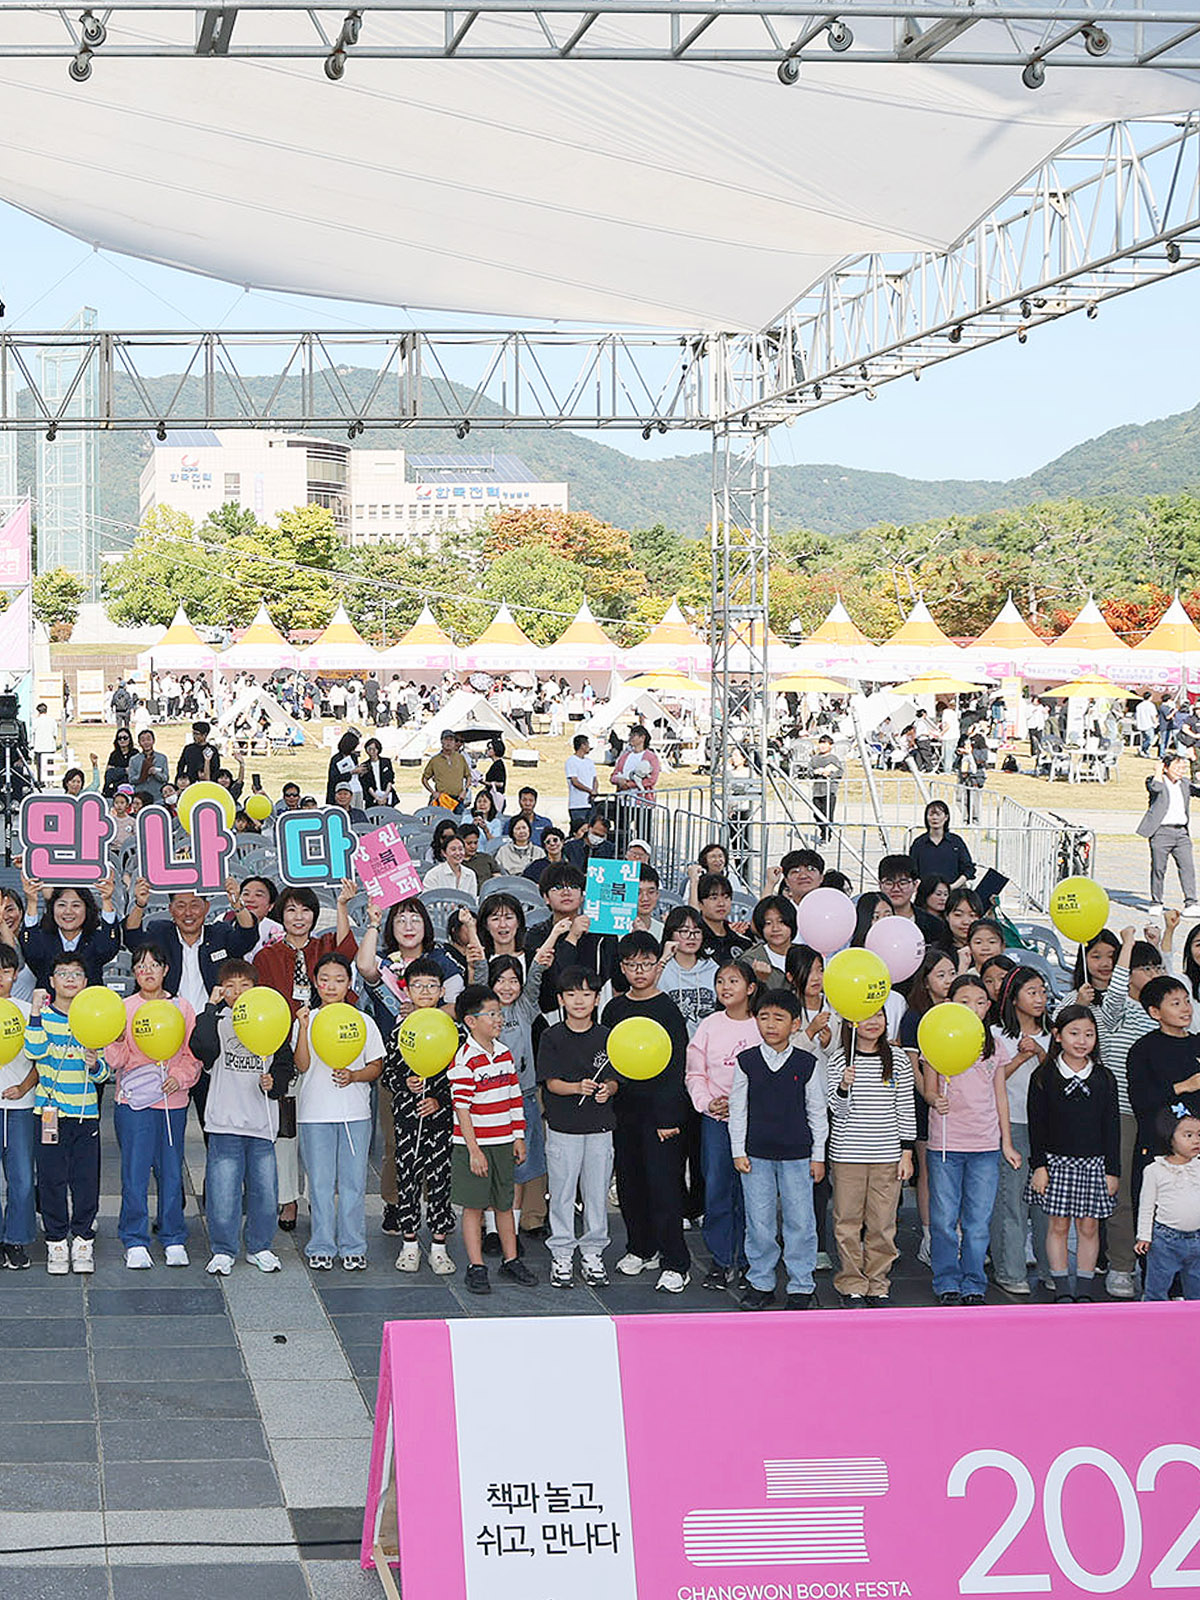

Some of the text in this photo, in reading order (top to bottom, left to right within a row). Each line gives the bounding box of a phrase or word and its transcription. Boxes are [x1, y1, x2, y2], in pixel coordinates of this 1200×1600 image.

[435, 486, 500, 499] 한국전력
[26, 799, 108, 880] 만
[143, 806, 229, 888] 나
[282, 814, 352, 880] 다
[378, 823, 402, 847] 원
[378, 848, 398, 866] 북
[587, 860, 640, 884] 창 원
[363, 876, 424, 897] 북 페
[610, 882, 627, 902] 북
[583, 899, 600, 921] 북
[487, 1482, 603, 1514] 책과 놀고,
[476, 1522, 621, 1557] 쉬고, 만나다
[678, 1581, 912, 1600] CHANGWON BOOK FESTA
